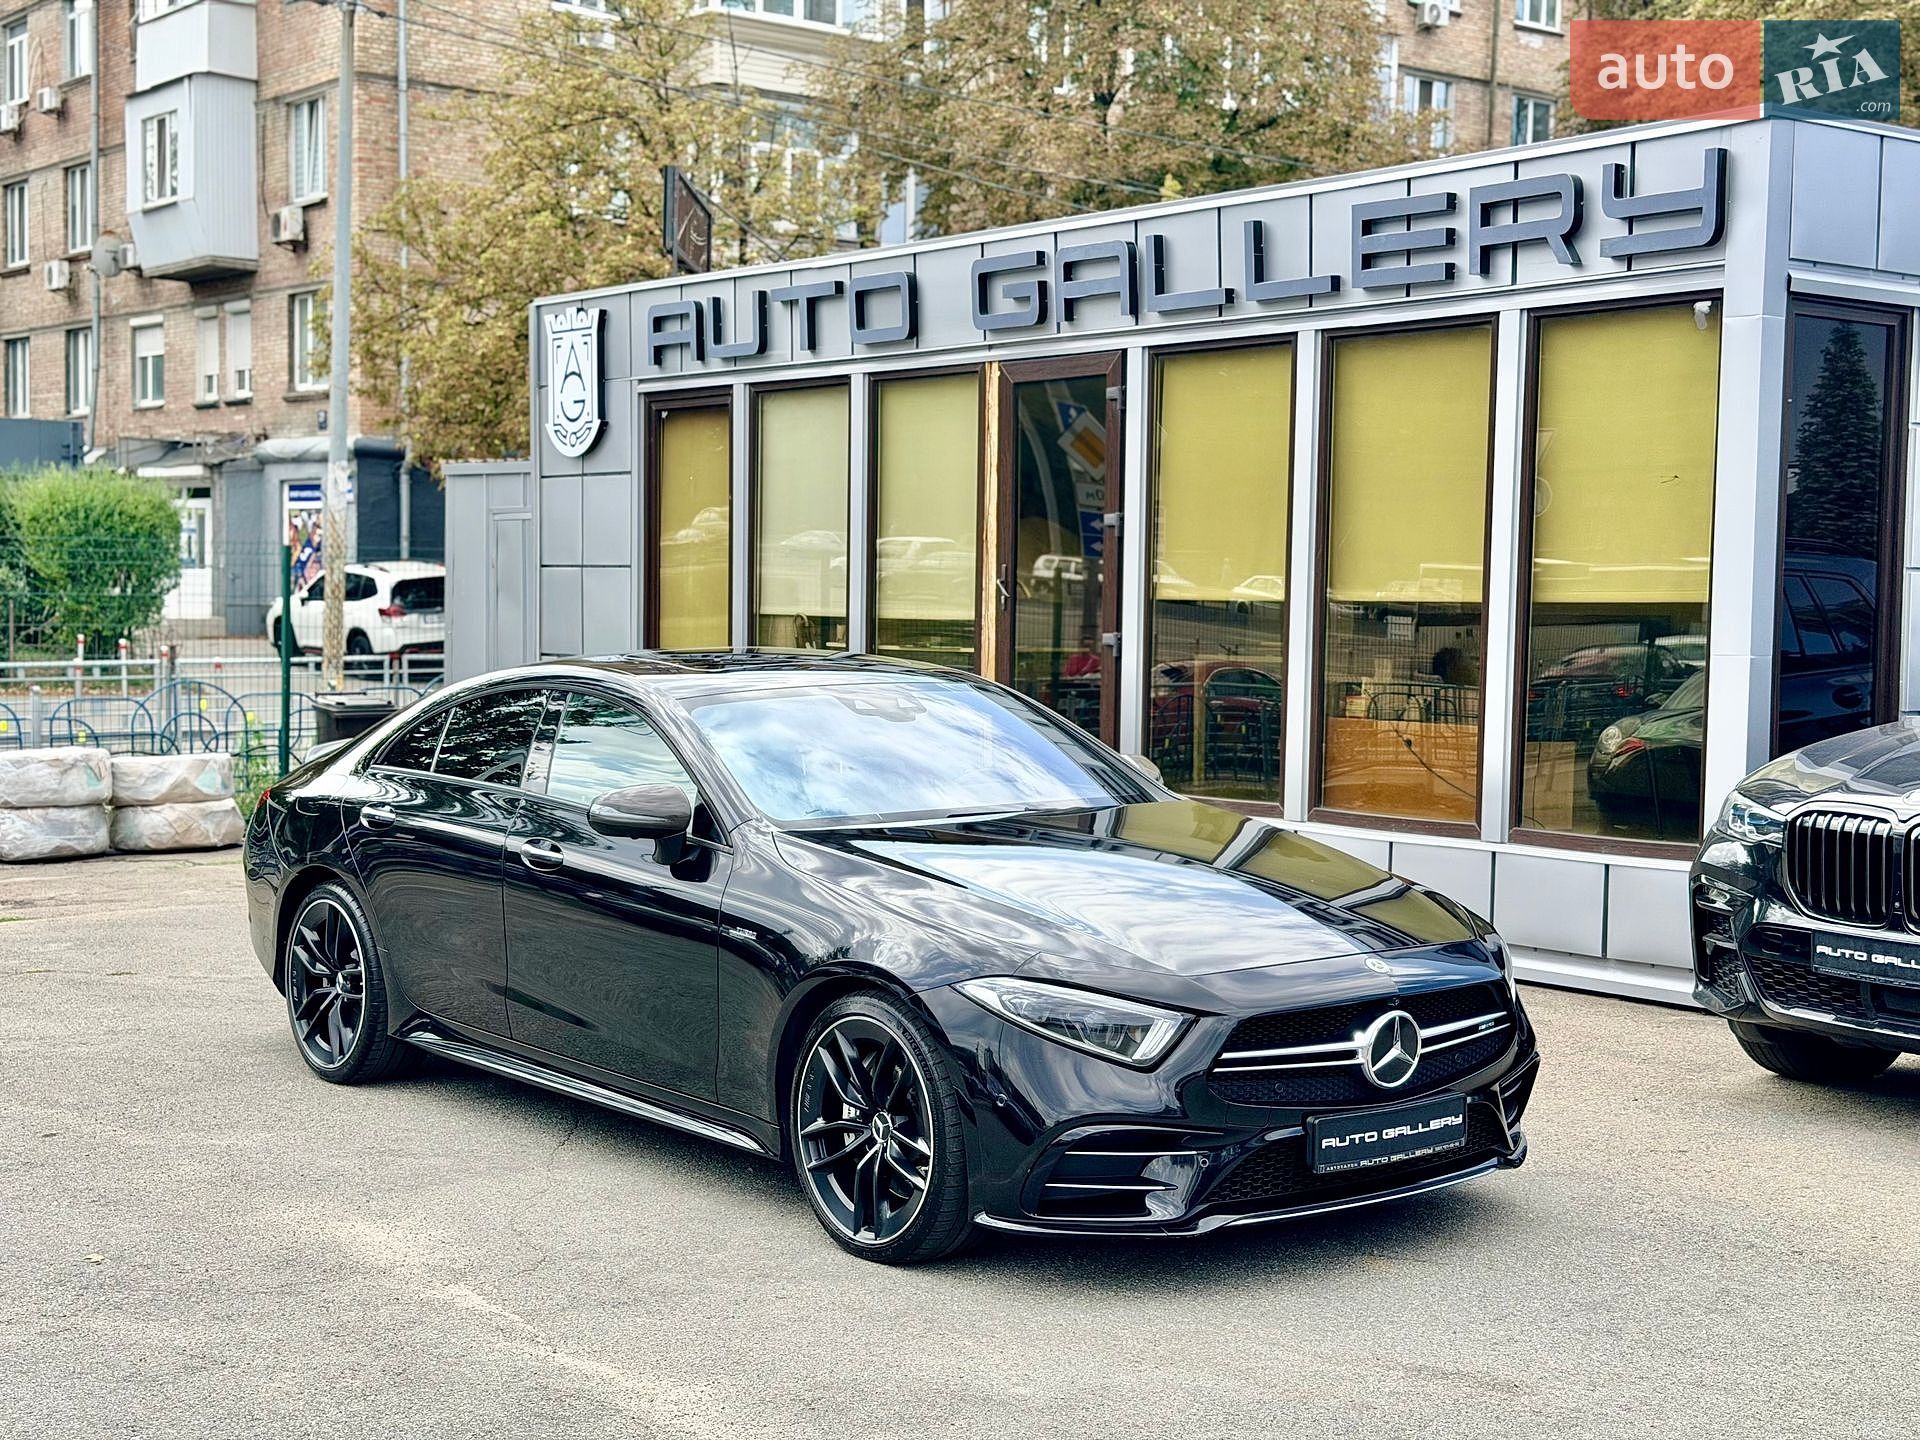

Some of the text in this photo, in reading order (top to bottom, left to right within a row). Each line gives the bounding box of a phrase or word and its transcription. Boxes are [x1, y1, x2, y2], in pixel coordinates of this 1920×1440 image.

[648, 147, 1727, 366] AUTO GALLERY
[1816, 945, 1867, 961] AUTO
[1321, 1113, 1463, 1149] AUTO GALLERY
[1360, 1147, 1433, 1167] AUTO GALLERY
